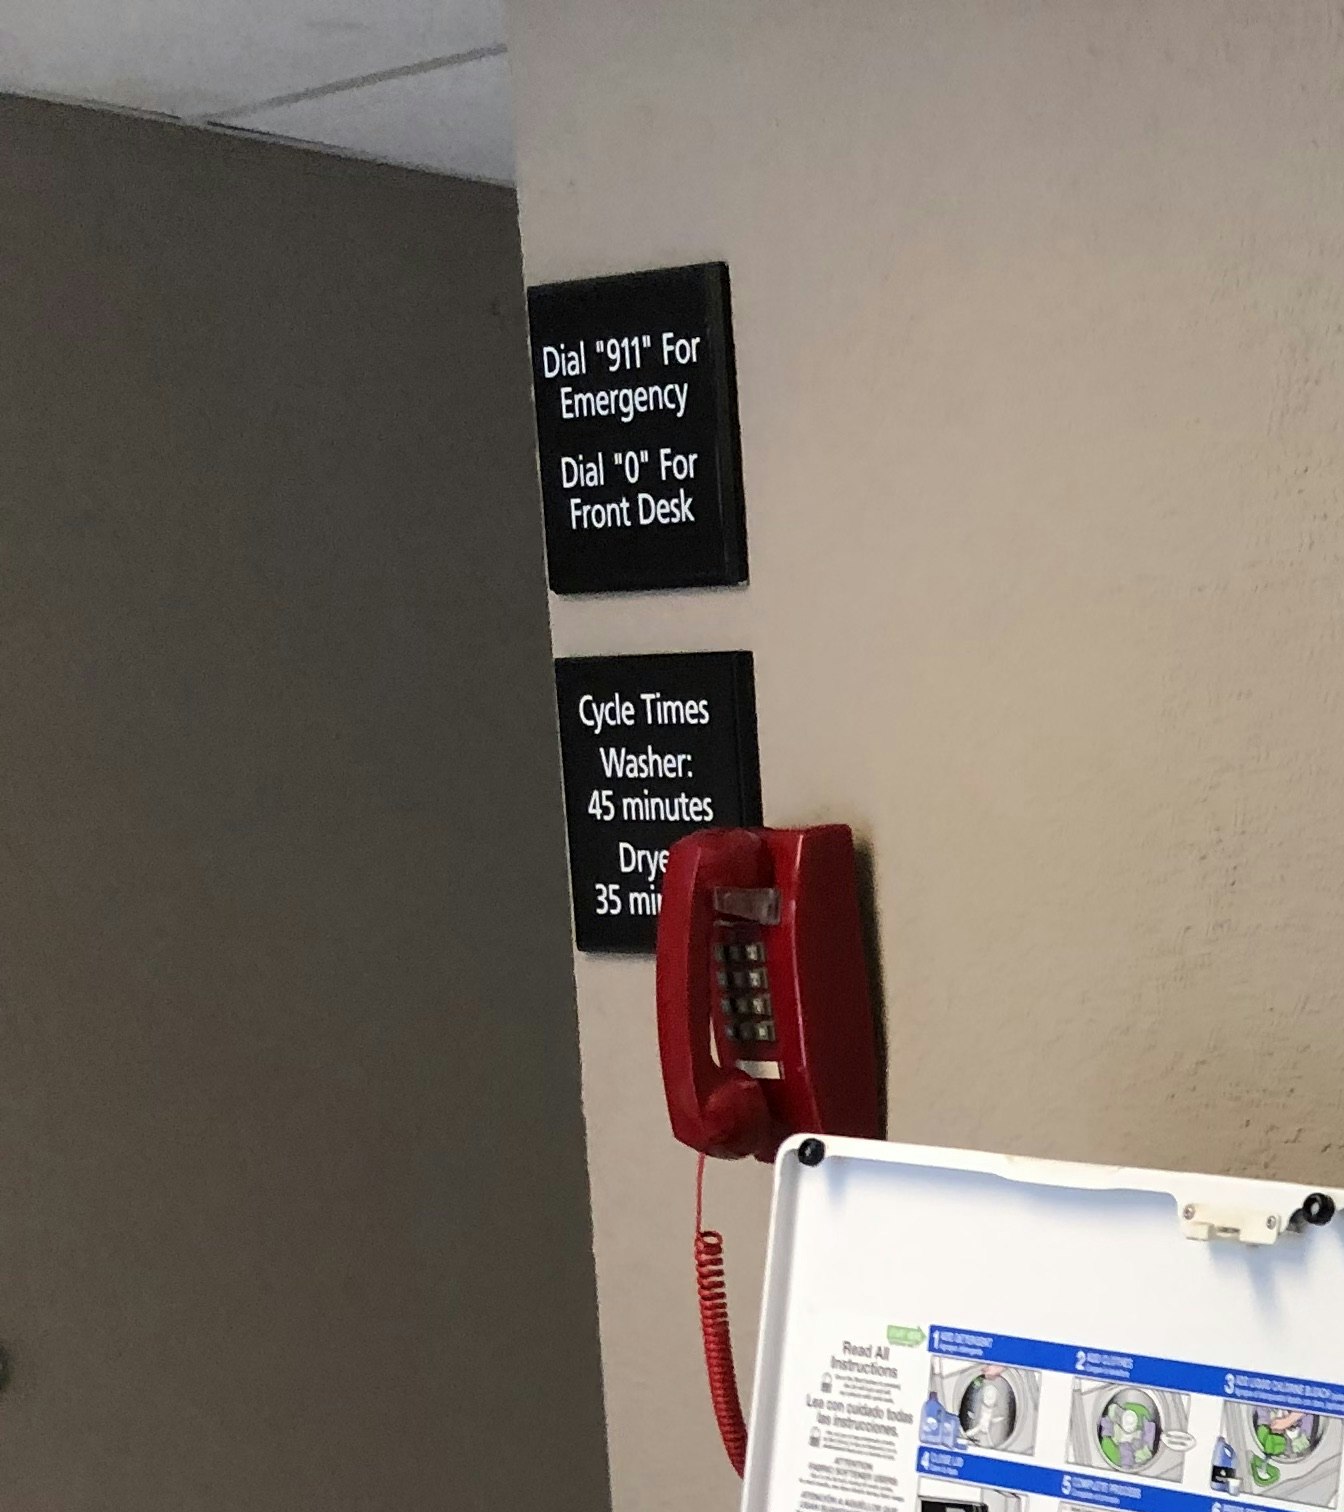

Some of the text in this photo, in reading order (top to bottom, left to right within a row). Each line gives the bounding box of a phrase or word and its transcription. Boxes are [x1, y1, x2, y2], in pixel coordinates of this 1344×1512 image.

[543, 332, 700, 378] Dial "911" For
[560, 383, 688, 422] Emergency
[561, 448, 698, 488] Dial "0" For
[570, 488, 695, 529] Front Desk
[579, 692, 709, 734] Cycle Times
[599, 745, 693, 778] Washer:
[588, 789, 713, 821] 45 minutes
[595, 883, 622, 915] 35
[831, 1355, 898, 1379] Instructions
[842, 1340, 890, 1361] Read All
